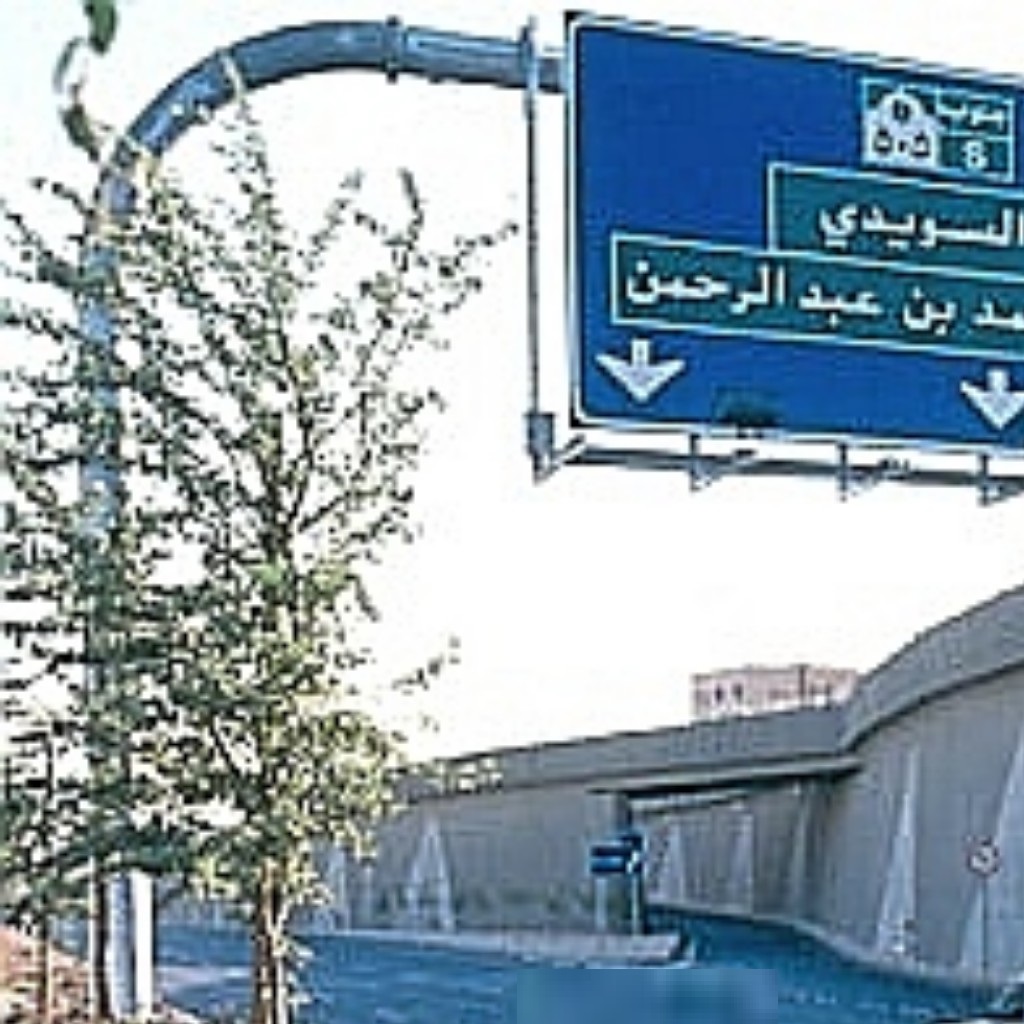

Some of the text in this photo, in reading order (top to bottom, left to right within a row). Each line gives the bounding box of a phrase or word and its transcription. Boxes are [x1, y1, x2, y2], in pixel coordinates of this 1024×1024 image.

[625, 260, 787, 314] الرحمن
[798, 284, 883, 328] عبد
[901, 286, 957, 337] بن
